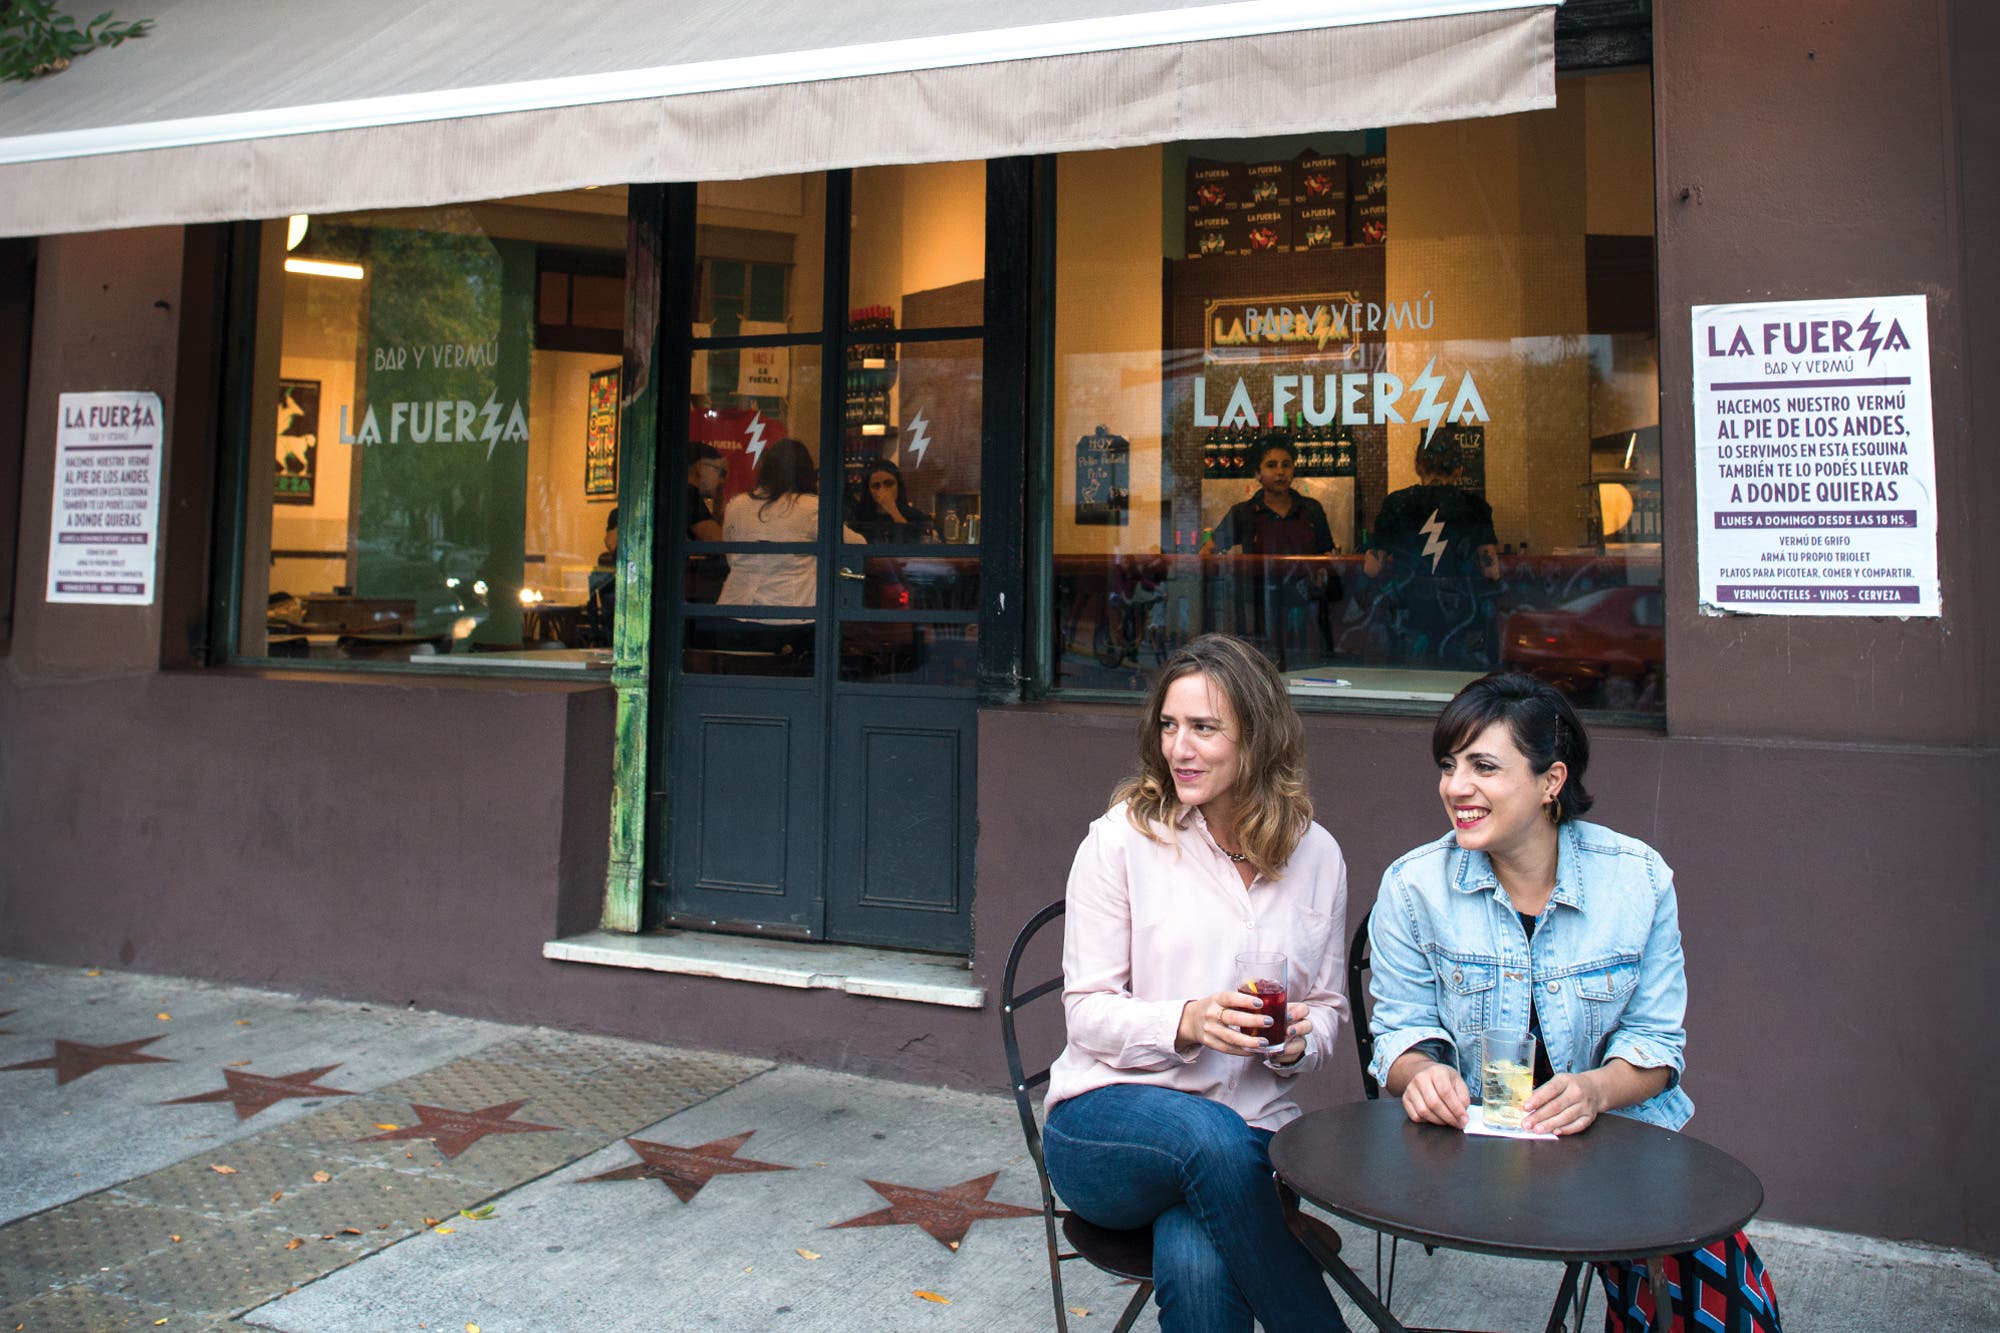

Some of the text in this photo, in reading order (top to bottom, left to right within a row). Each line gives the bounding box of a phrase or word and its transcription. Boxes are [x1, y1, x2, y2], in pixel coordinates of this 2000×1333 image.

[1246, 291, 1435, 336] BAR Y VERMÚ
[1214, 317, 1248, 344] LA
[1708, 308, 1911, 367] LA FUERZA
[375, 333, 499, 371] BAR Y VERMÚ
[1765, 356, 1854, 375] BAR Y VERMÚ
[1193, 354, 1490, 449] LA FUERZA
[1717, 390, 1906, 415] HACEMOS NUESTRO VERMÚ
[65, 408, 85, 428] LA
[339, 386, 529, 462] LA FUERZA
[1718, 415, 1910, 440] AL PIE DE LOS ANDES,
[1718, 441, 1908, 459] LO SERVIMOS EN ESTA ESQUINA
[103, 470, 119, 483] LOS
[1719, 459, 1909, 478] TAMBIÉN TE LO PODÉS LLEVAR
[1731, 481, 1899, 503] A DONDE QUIERAS
[1721, 514, 1908, 526] LUNES A DOMINGO DESDE LAS 18 HS.
[1779, 533, 1851, 546] VERMÚ DE GRIFO
[1760, 550, 1871, 562] ARMÁ TU PROPIO TRIOLET
[1720, 568, 1915, 579] PLATOS PARA PICOTEAR, COMER Y COMPARTIR.
[1733, 587, 1810, 600] VERMUCÓCTELES
[1819, 590, 1849, 600] VINOS
[1858, 590, 1901, 601] CERVEZA
